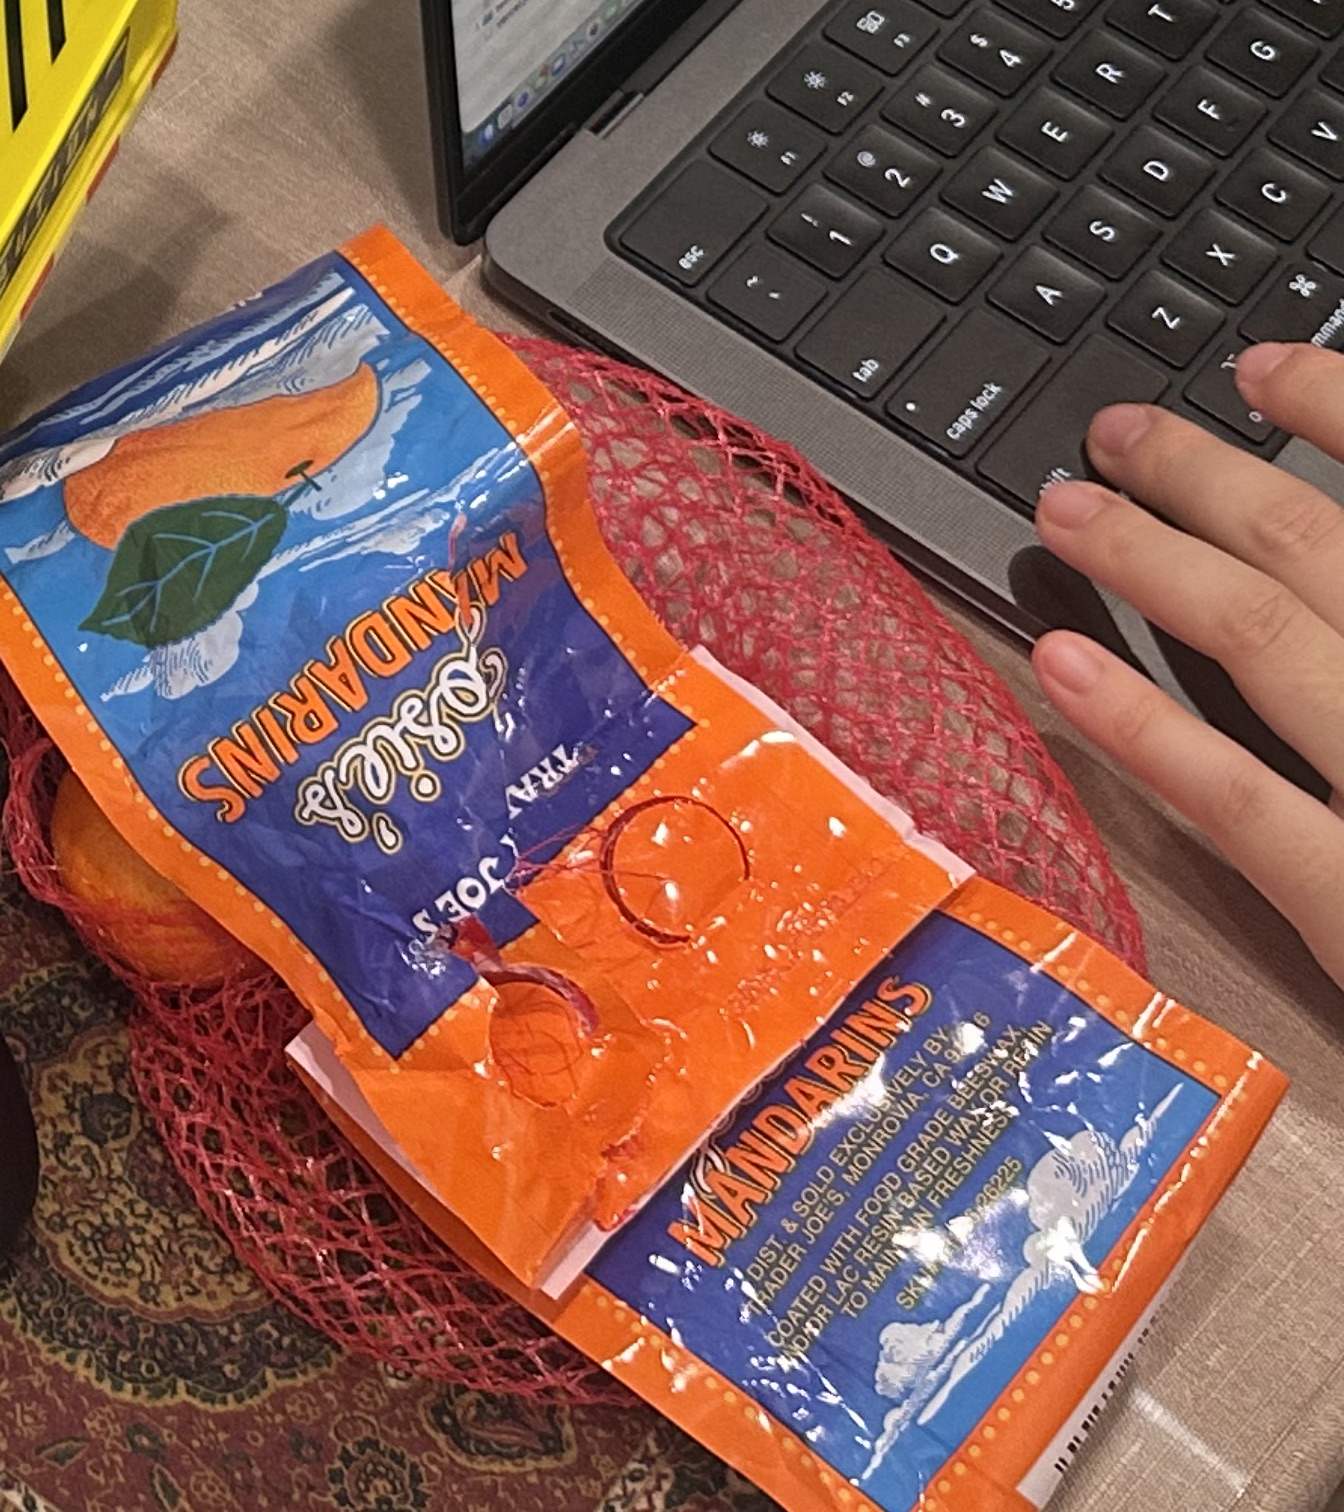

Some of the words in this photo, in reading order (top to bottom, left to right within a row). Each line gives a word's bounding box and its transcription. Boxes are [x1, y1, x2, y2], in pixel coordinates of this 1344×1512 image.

[1147, 2, 1176, 27] T
[1094, 61, 1126, 86] R
[1042, 120, 1071, 145] E
[981, 178, 1015, 205] W
[678, 244, 705, 271] esc
[929, 243, 961, 265] Q
[852, 357, 880, 384] tab
[945, 406, 980, 441] caps
[969, 381, 1004, 416] lock
[176, 530, 531, 826] MANDARINS
[668, 974, 935, 1270] MANDARINS
[746, 1233, 787, 1282] DIST.
[780, 1217, 799, 1234] &
[792, 1165, 835, 1217] SOLD
[828, 1050, 931, 1168] EXCLUSIVELY
[922, 1025, 951, 1056] BY
[746, 1241, 808, 1316] TRADER
[802, 1187, 853, 1244] JOE'S,
[840, 1084, 930, 1187] MONROVIA,
[920, 1057, 951, 1090] CA
[826, 1264, 859, 1305] LAC
[852, 1144, 953, 1267] RESIN-BASED
[977, 1073, 1009, 1108] OR
[768, 1274, 828, 1347] COATED
[819, 1224, 862, 1276] WITH
[854, 1172, 902, 1227] FOOD
[895, 1106, 953, 1175] GRADE
[842, 1290, 869, 1318] TO
